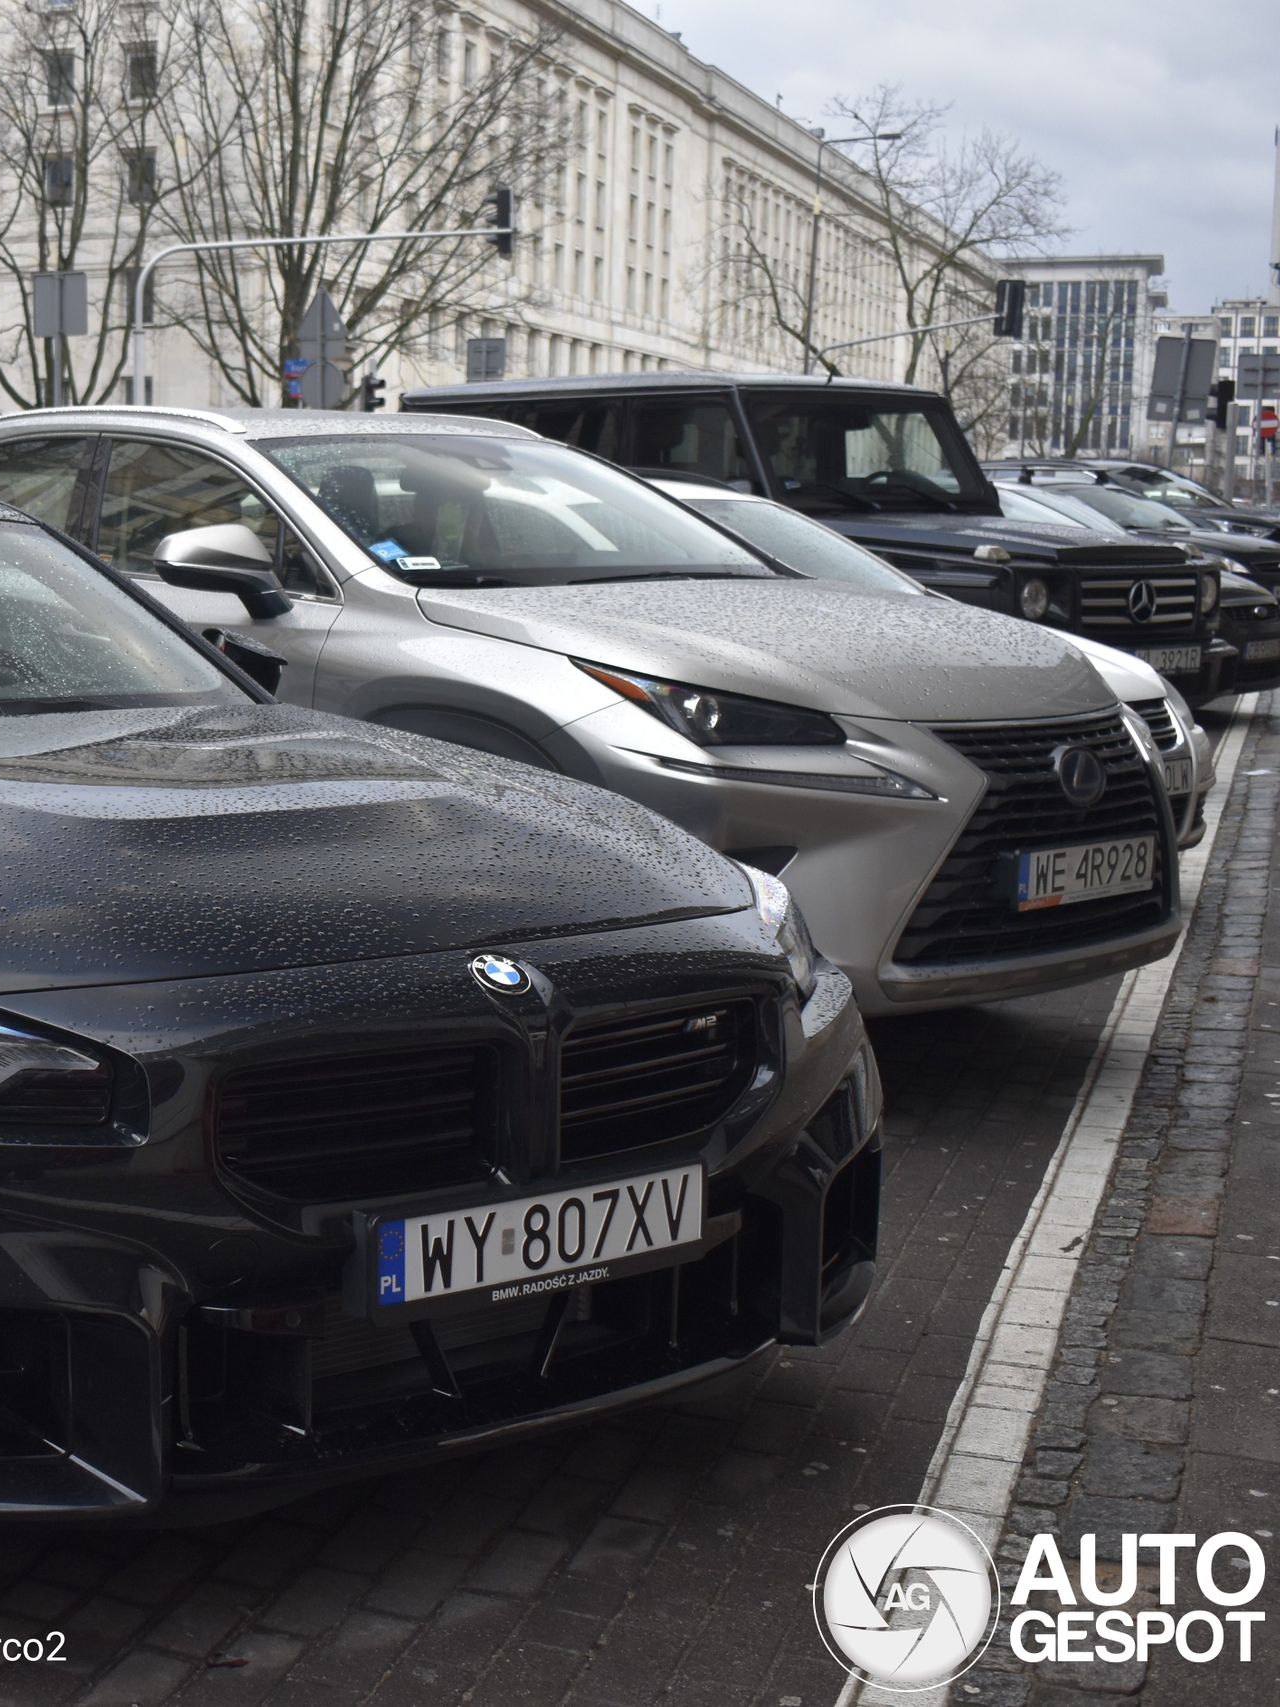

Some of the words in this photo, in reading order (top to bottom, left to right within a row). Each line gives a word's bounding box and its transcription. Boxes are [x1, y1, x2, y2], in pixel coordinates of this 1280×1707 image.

[1160, 649, 1198, 670] 3921R
[1035, 853, 1066, 896] WE
[1075, 841, 1148, 888] 4R928
[694, 1015, 717, 1029] M2
[421, 1212, 496, 1292] WY
[521, 1174, 689, 1270] 807XV
[380, 1275, 401, 1295] PL
[492, 1286, 522, 1302] BMW.
[523, 1274, 567, 1295] RADOŚĆ
[568, 1274, 575, 1285] Z
[576, 1267, 610, 1283] JAZDY.
